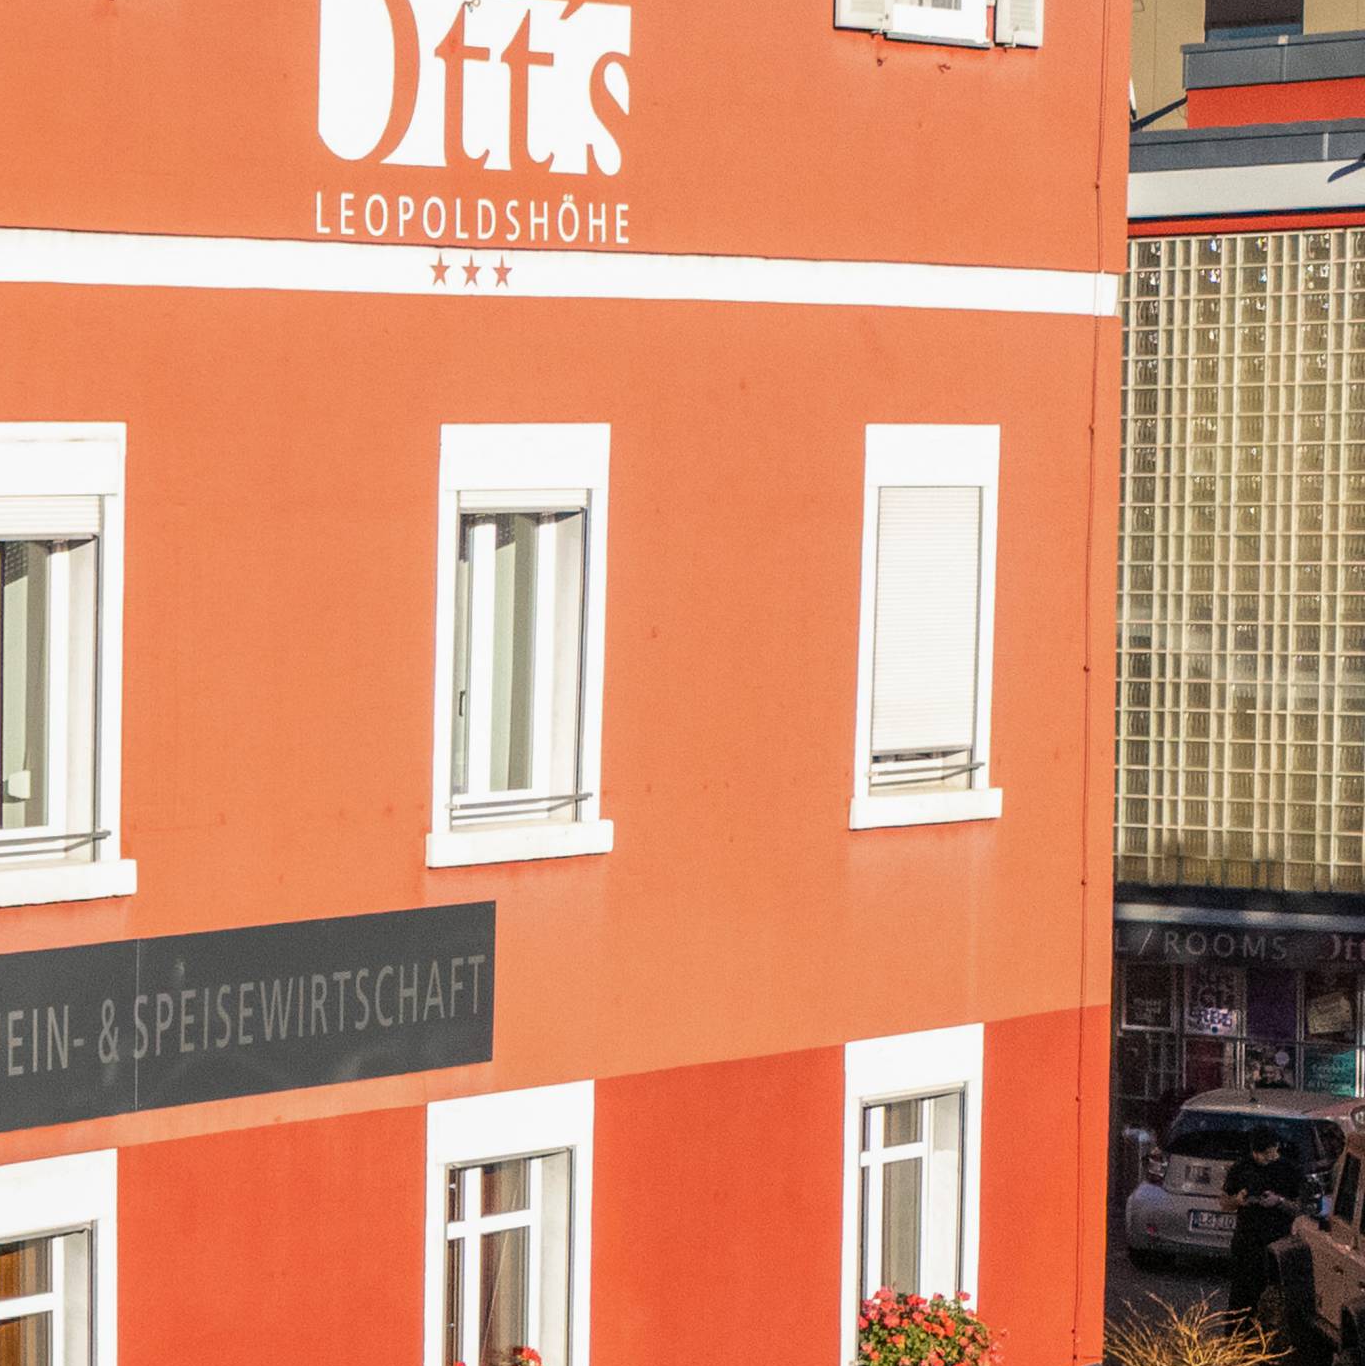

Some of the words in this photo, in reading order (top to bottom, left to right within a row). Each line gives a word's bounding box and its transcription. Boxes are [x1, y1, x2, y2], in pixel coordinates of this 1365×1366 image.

[315, 191, 630, 244] LEOPOLDSHÖHE
[1163, 930, 1288, 960] ROOMS
[98, 998, 120, 1065] &
[133, 954, 487, 1060] SPEISEWIRTSCHAFT
